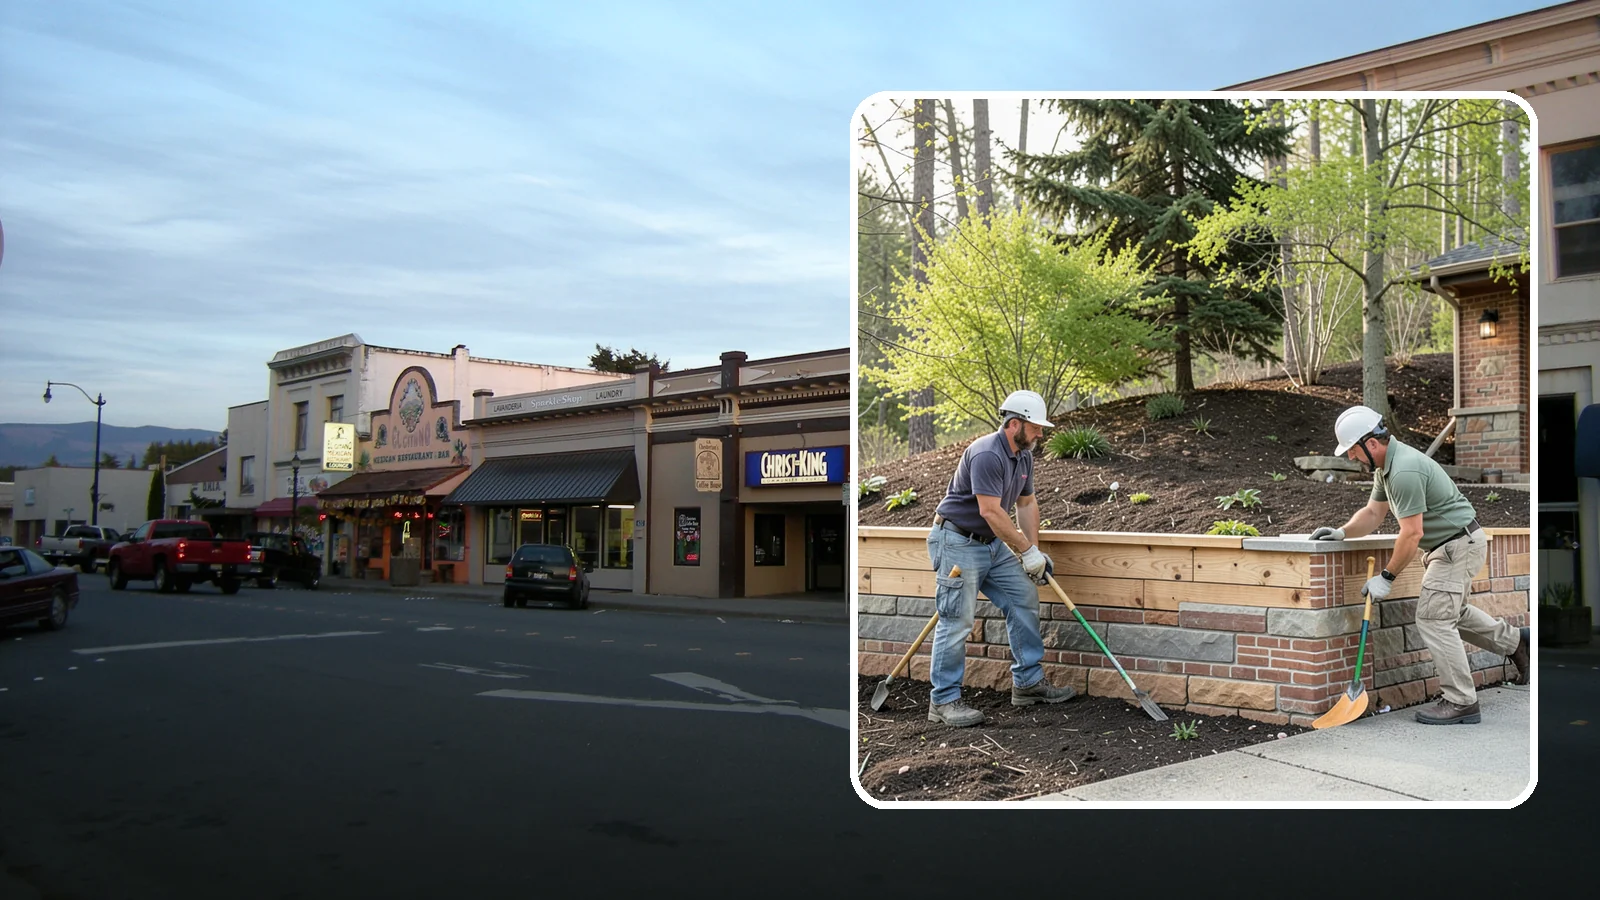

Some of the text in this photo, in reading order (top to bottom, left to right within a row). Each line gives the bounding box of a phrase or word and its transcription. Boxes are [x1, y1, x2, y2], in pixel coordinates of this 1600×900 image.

[595, 389, 623, 399] LAUNDRY
[493, 402, 522, 412] LAVANDERIA
[530, 395, 582, 409] Sparkle Shop
[373, 454, 396, 464] MEXICAN
[397, 451, 433, 462] RESTAURANT
[437, 450, 450, 459] BAR
[760, 450, 827, 478] CHRIST KING
[710, 481, 721, 489] House
